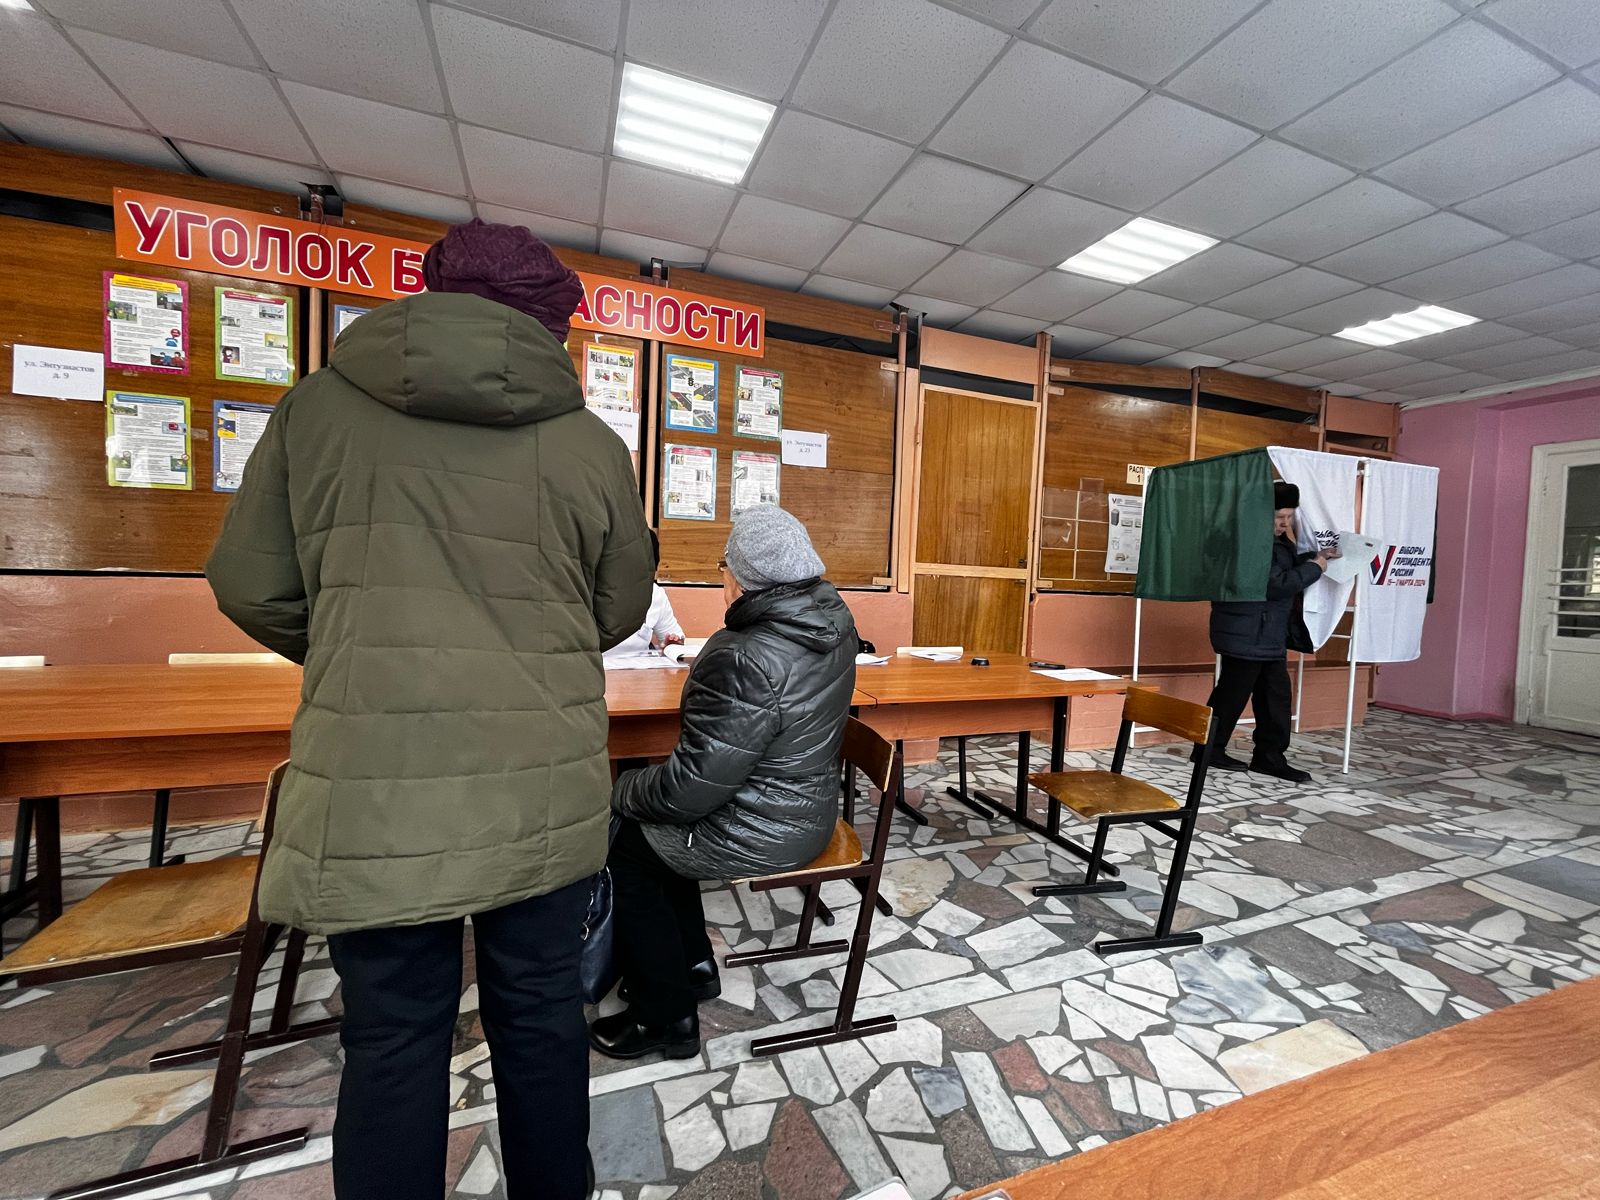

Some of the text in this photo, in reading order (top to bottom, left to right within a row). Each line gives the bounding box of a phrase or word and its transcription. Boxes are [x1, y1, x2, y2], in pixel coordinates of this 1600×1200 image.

[124, 200, 375, 289] УГОЛОК
[391, 248, 761, 350] БАСНОСТИ
[1129, 465, 1144, 474] РАСП
